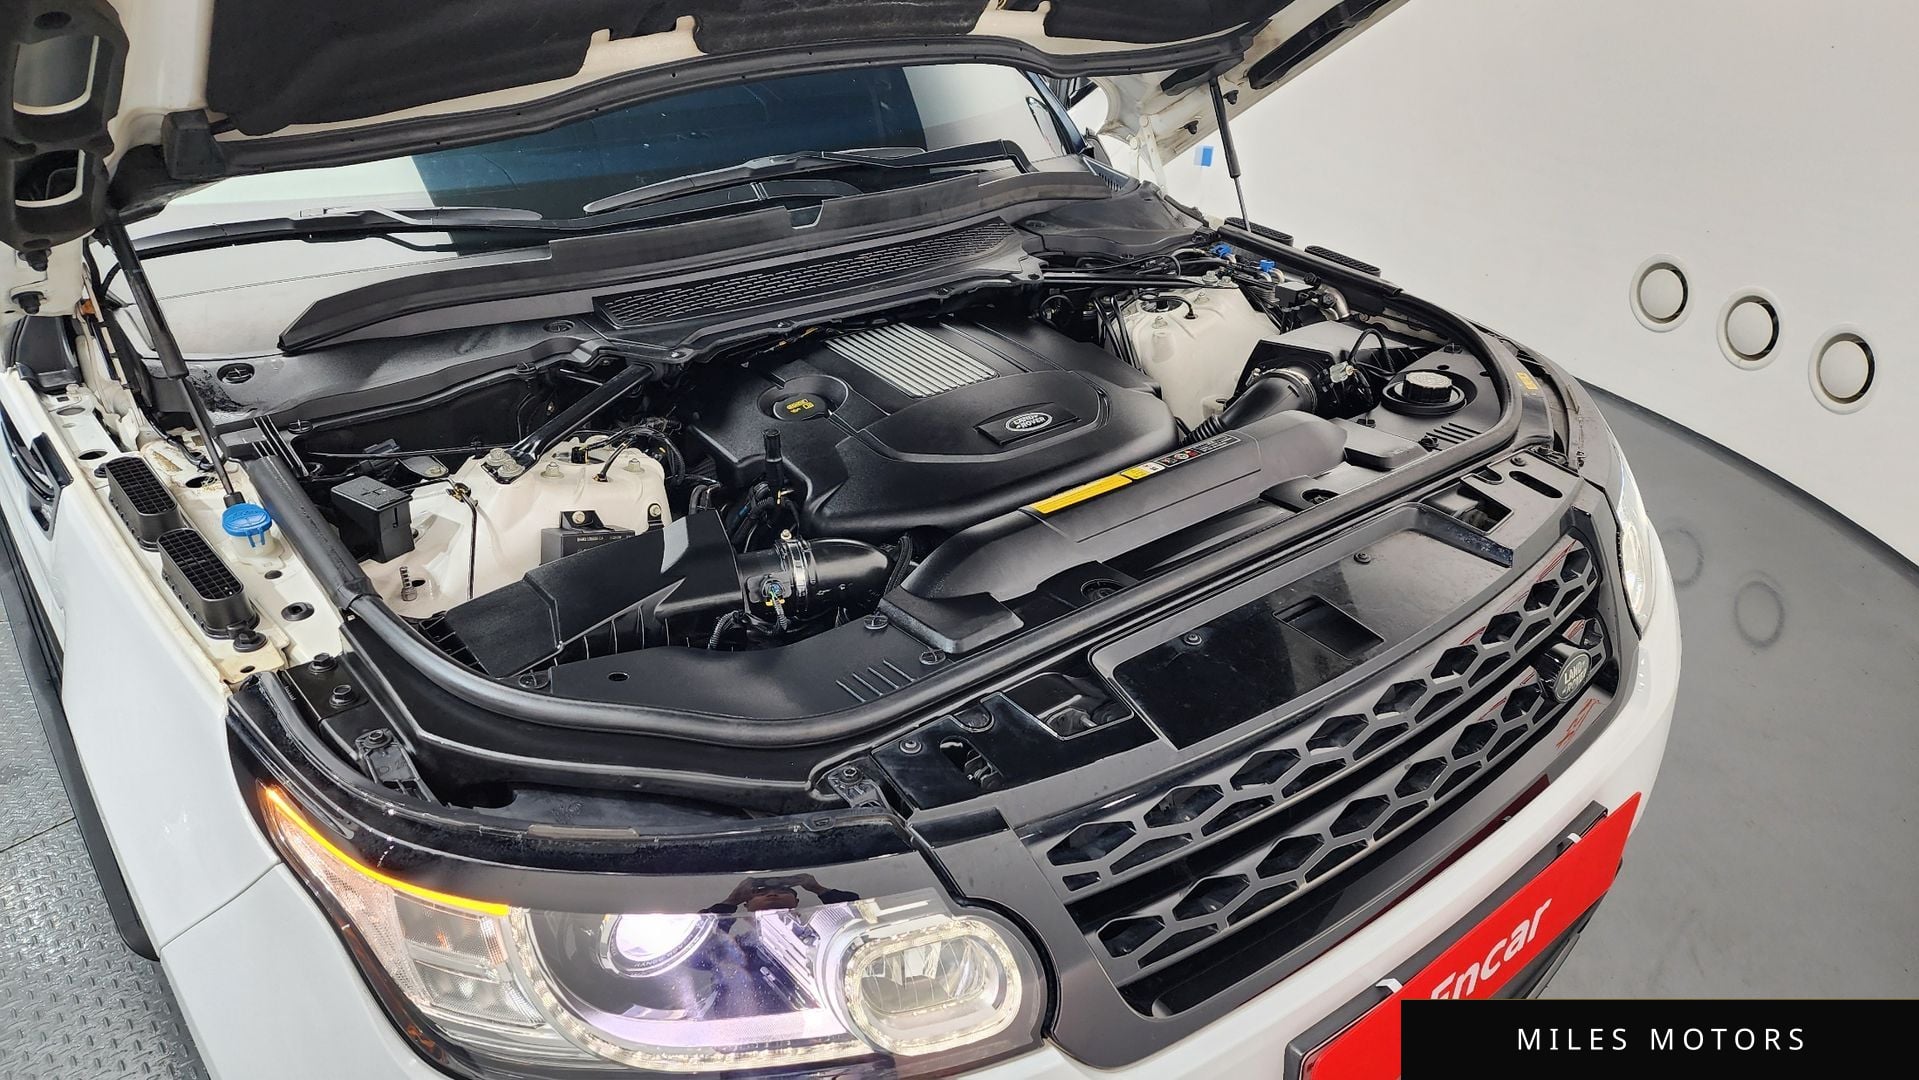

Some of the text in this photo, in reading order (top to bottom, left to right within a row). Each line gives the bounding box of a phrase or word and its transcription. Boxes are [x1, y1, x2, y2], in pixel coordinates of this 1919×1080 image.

[1021, 416, 1046, 428] ROVER
[1564, 660, 1583, 685] LAND
[1566, 668, 1588, 694] ROVER
[1430, 898, 1552, 1000] Encar
